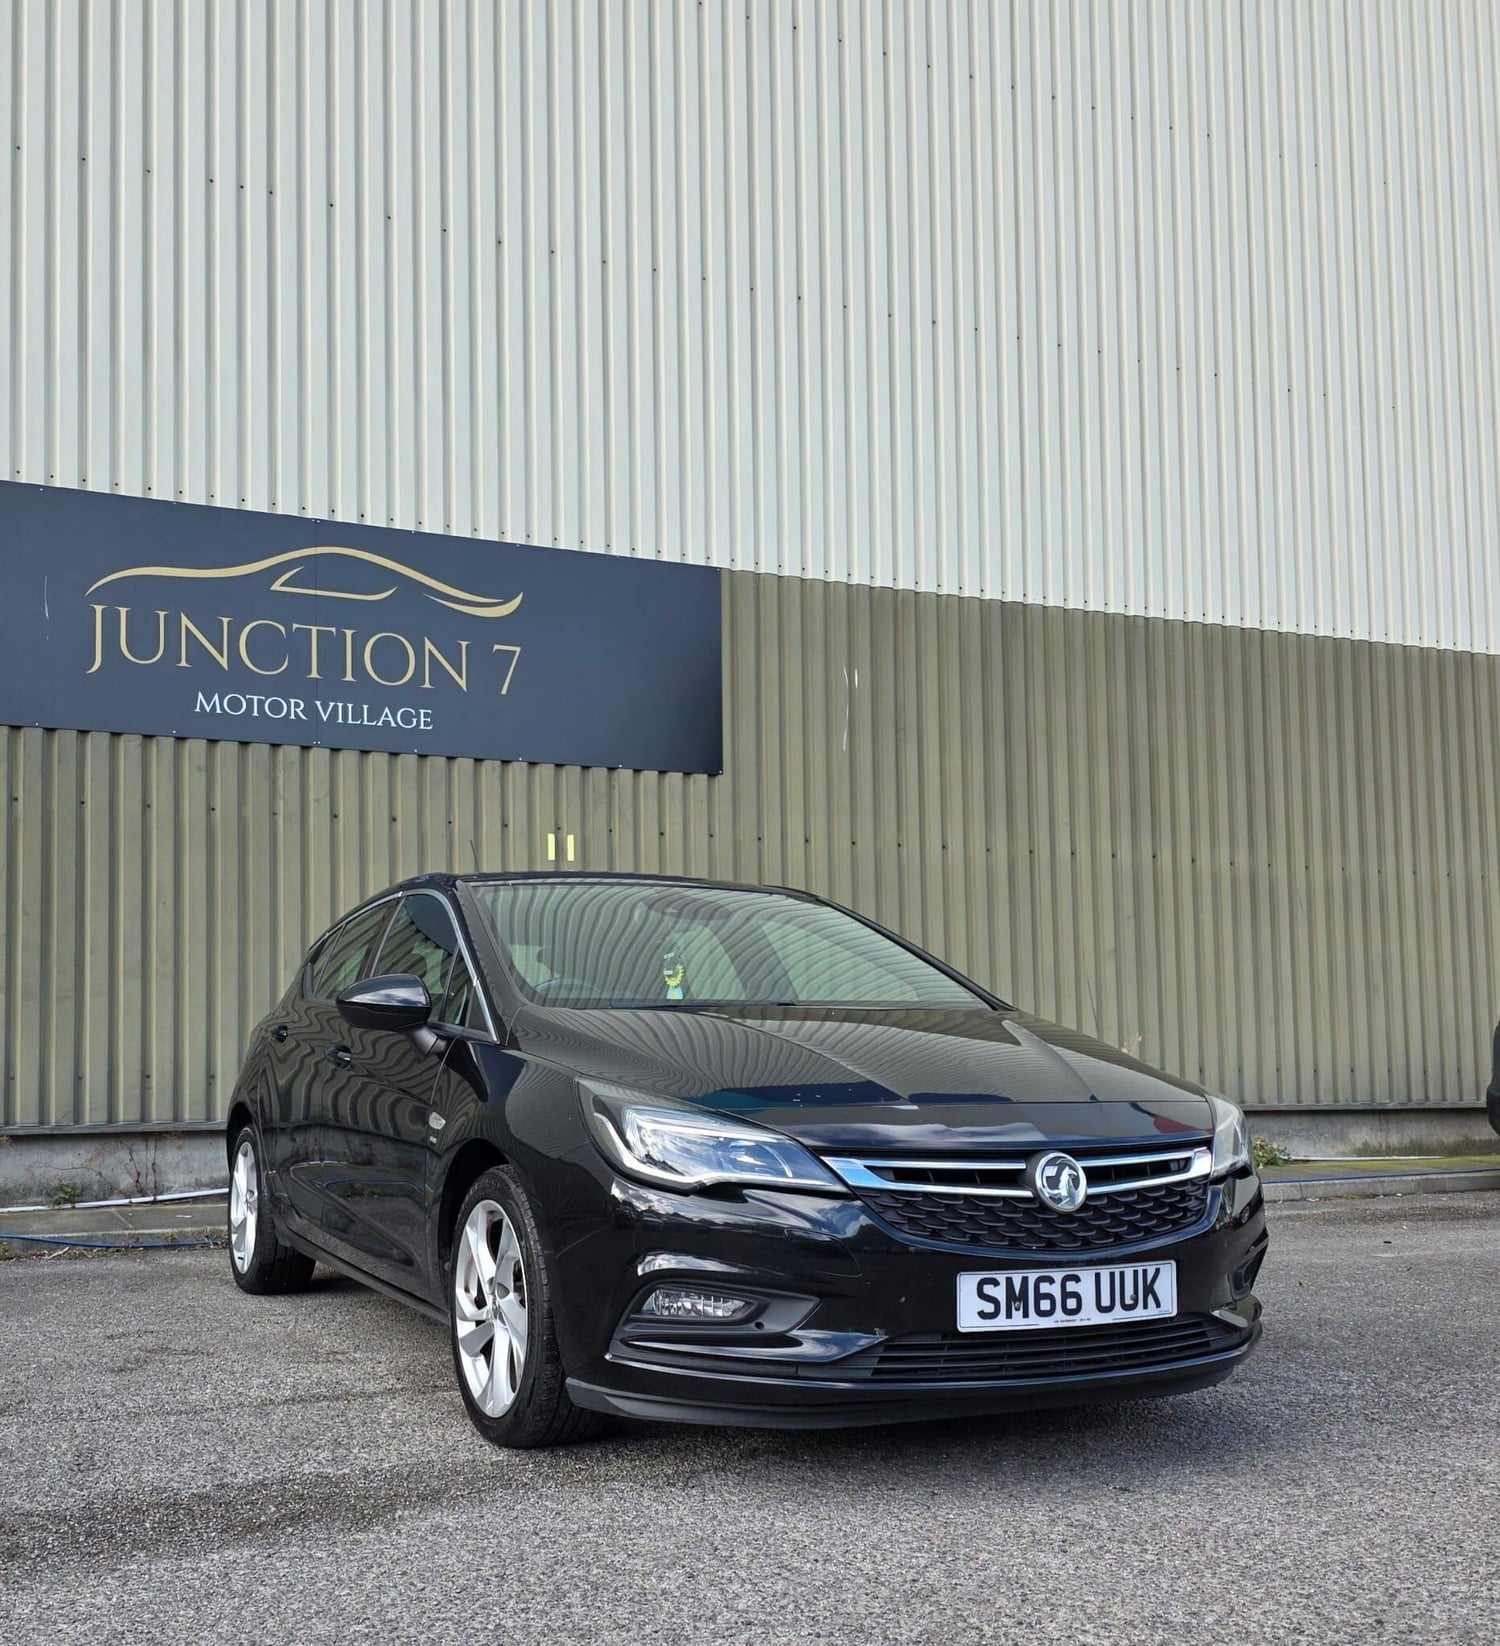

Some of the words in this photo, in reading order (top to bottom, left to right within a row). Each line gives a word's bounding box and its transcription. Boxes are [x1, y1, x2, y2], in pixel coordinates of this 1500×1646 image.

[85, 604, 471, 692] JUNCTION
[492, 644, 522, 695] 7
[194, 691, 307, 721] MOTOR
[315, 700, 433, 730] VILLAGE
[976, 1274, 1083, 1320] SM66
[1094, 1267, 1162, 1314] UUK
